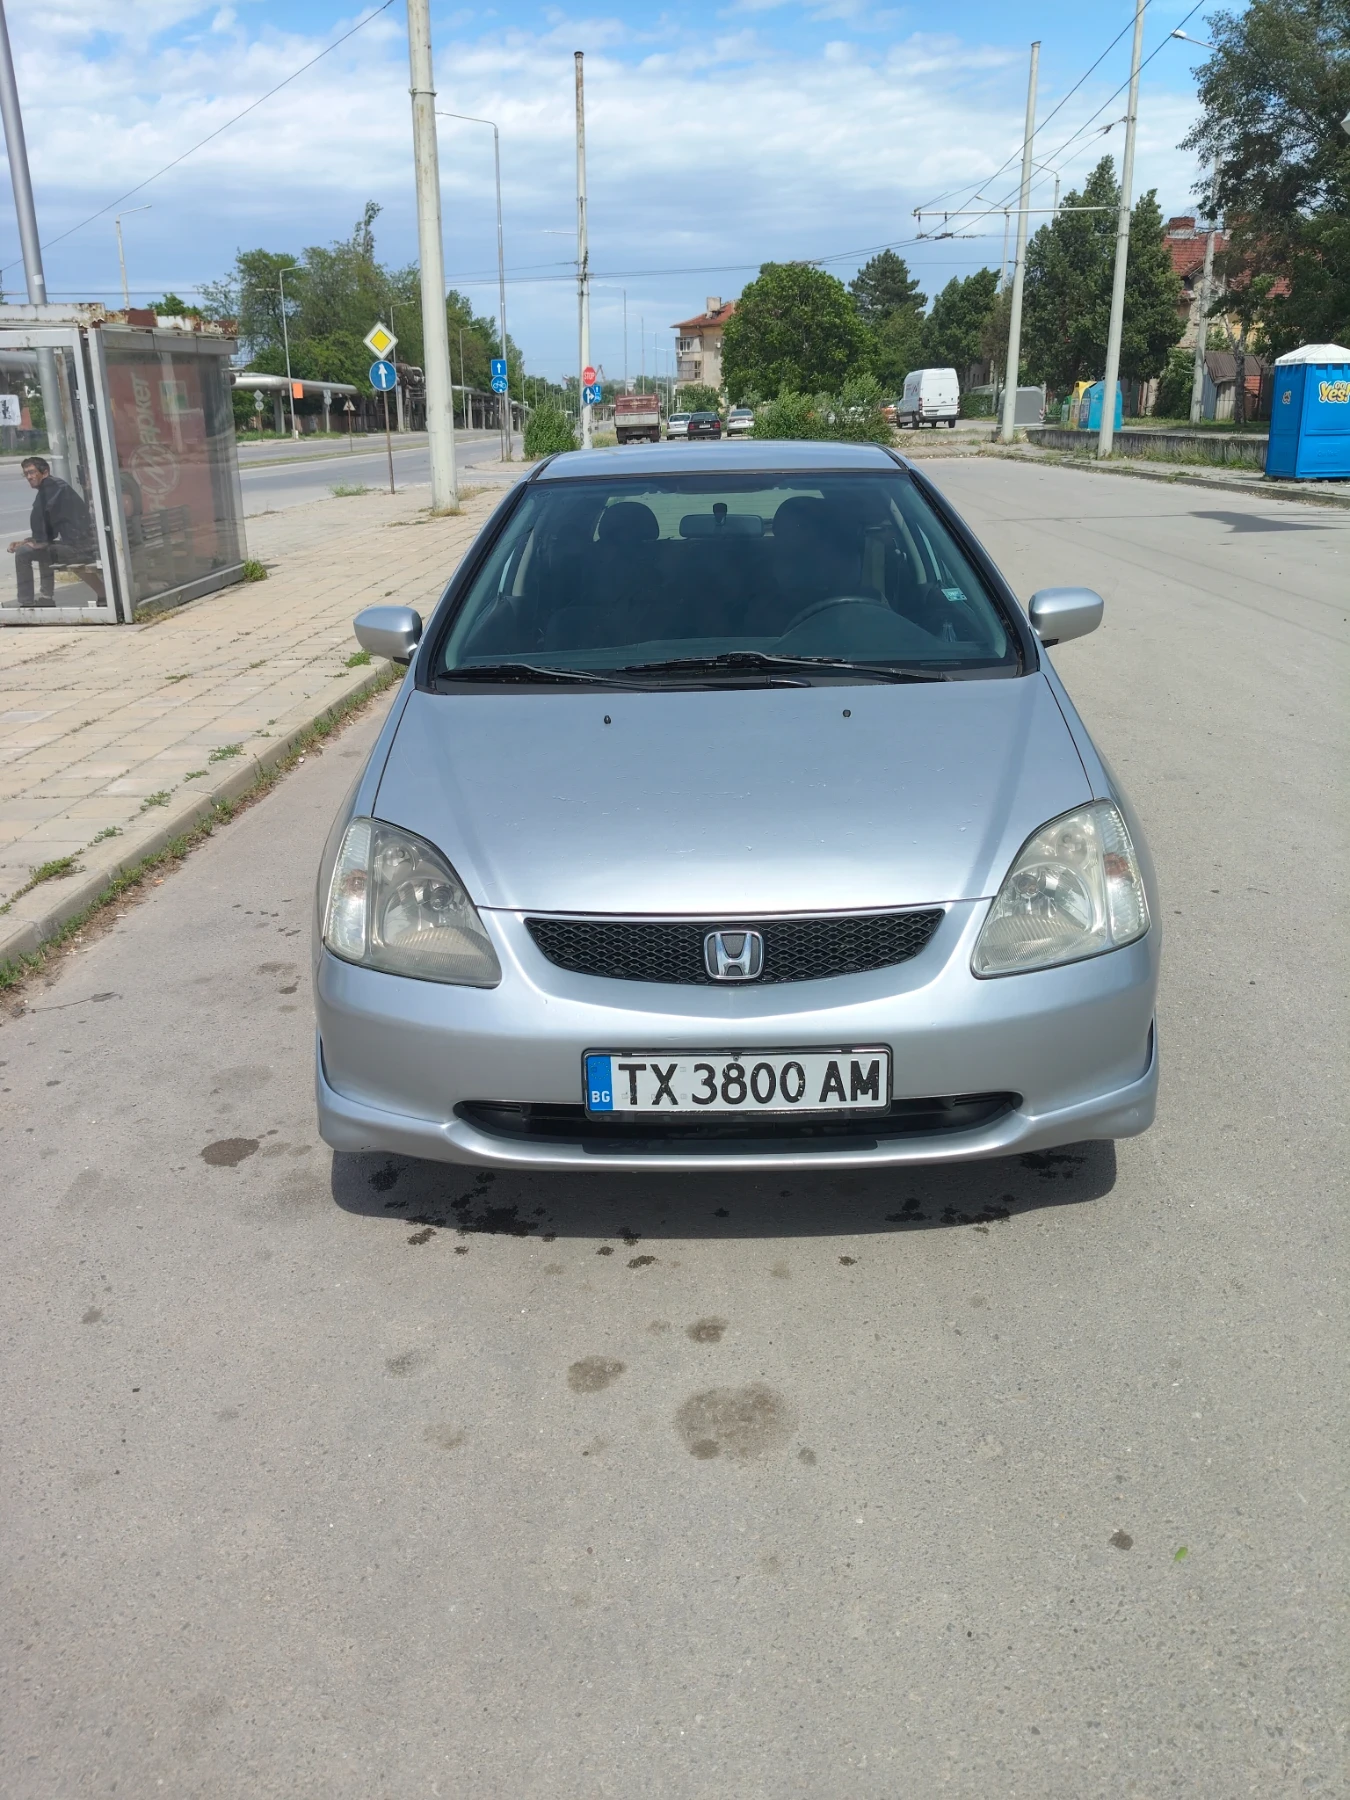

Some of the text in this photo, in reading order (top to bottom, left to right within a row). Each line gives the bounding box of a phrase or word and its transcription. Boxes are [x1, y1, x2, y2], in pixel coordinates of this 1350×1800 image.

[591, 1059, 880, 1105] BG TX 3800 AM
